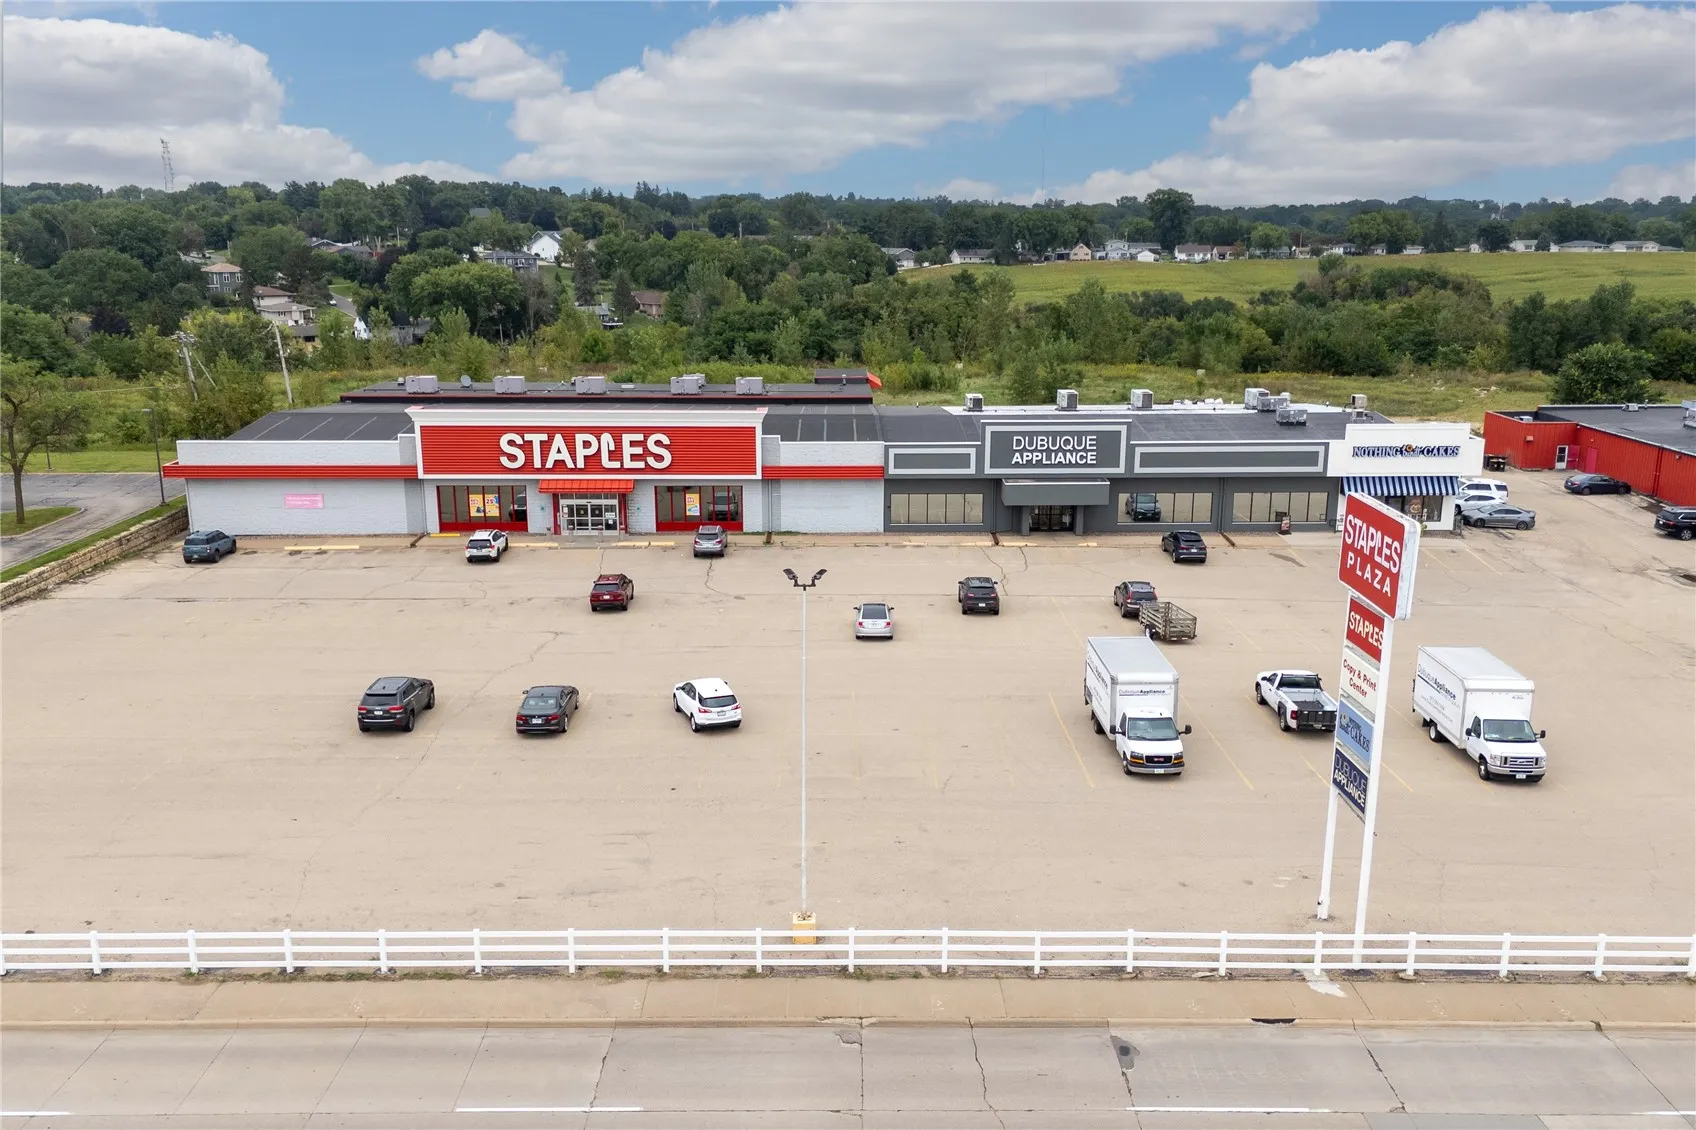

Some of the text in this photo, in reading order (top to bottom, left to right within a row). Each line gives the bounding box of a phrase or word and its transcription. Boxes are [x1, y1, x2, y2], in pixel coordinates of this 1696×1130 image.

[499, 432, 672, 470] STAPLES
[1011, 452, 1097, 465] APPLIANCE
[1012, 436, 1097, 451] DUBUQUE
[1352, 446, 1400, 458] NOTHING
[1423, 446, 1460, 458] CAKES
[1345, 514, 1401, 574] STAPLES
[1347, 551, 1391, 597] PLAZA
[1349, 611, 1384, 650] STAPLES
[1343, 659, 1377, 691] Copy & Print
[1349, 677, 1368, 698] Center
[1334, 769, 1366, 807] APPLIANCE
[1335, 754, 1367, 794] DUBUQUE
